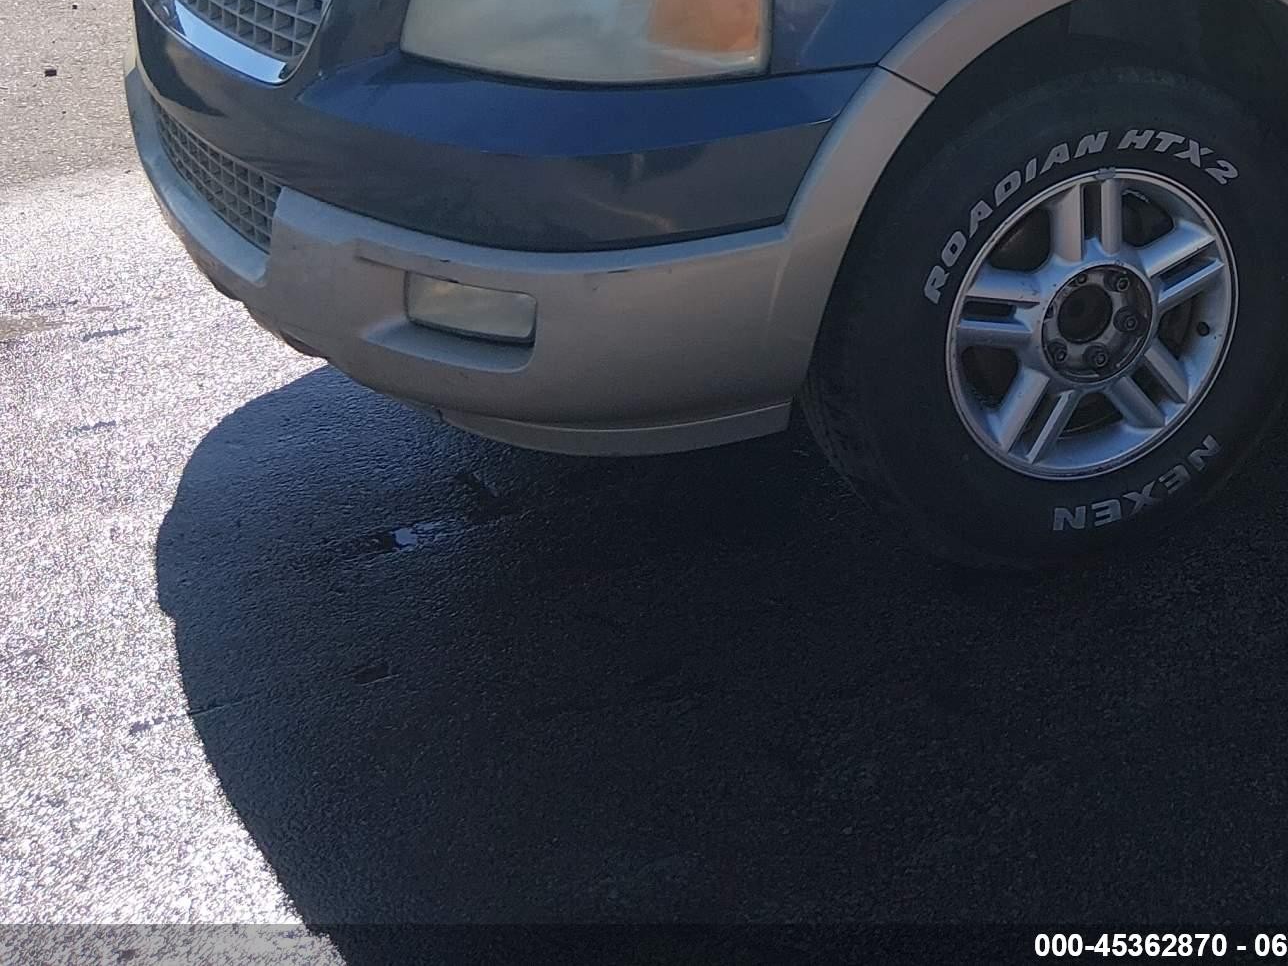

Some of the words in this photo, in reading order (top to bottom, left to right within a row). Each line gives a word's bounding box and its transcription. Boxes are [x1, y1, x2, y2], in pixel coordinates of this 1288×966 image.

[924, 131, 1109, 305] ROADIAN
[1118, 129, 1239, 185] HTX2
[1052, 434, 1223, 532] NEXEN
